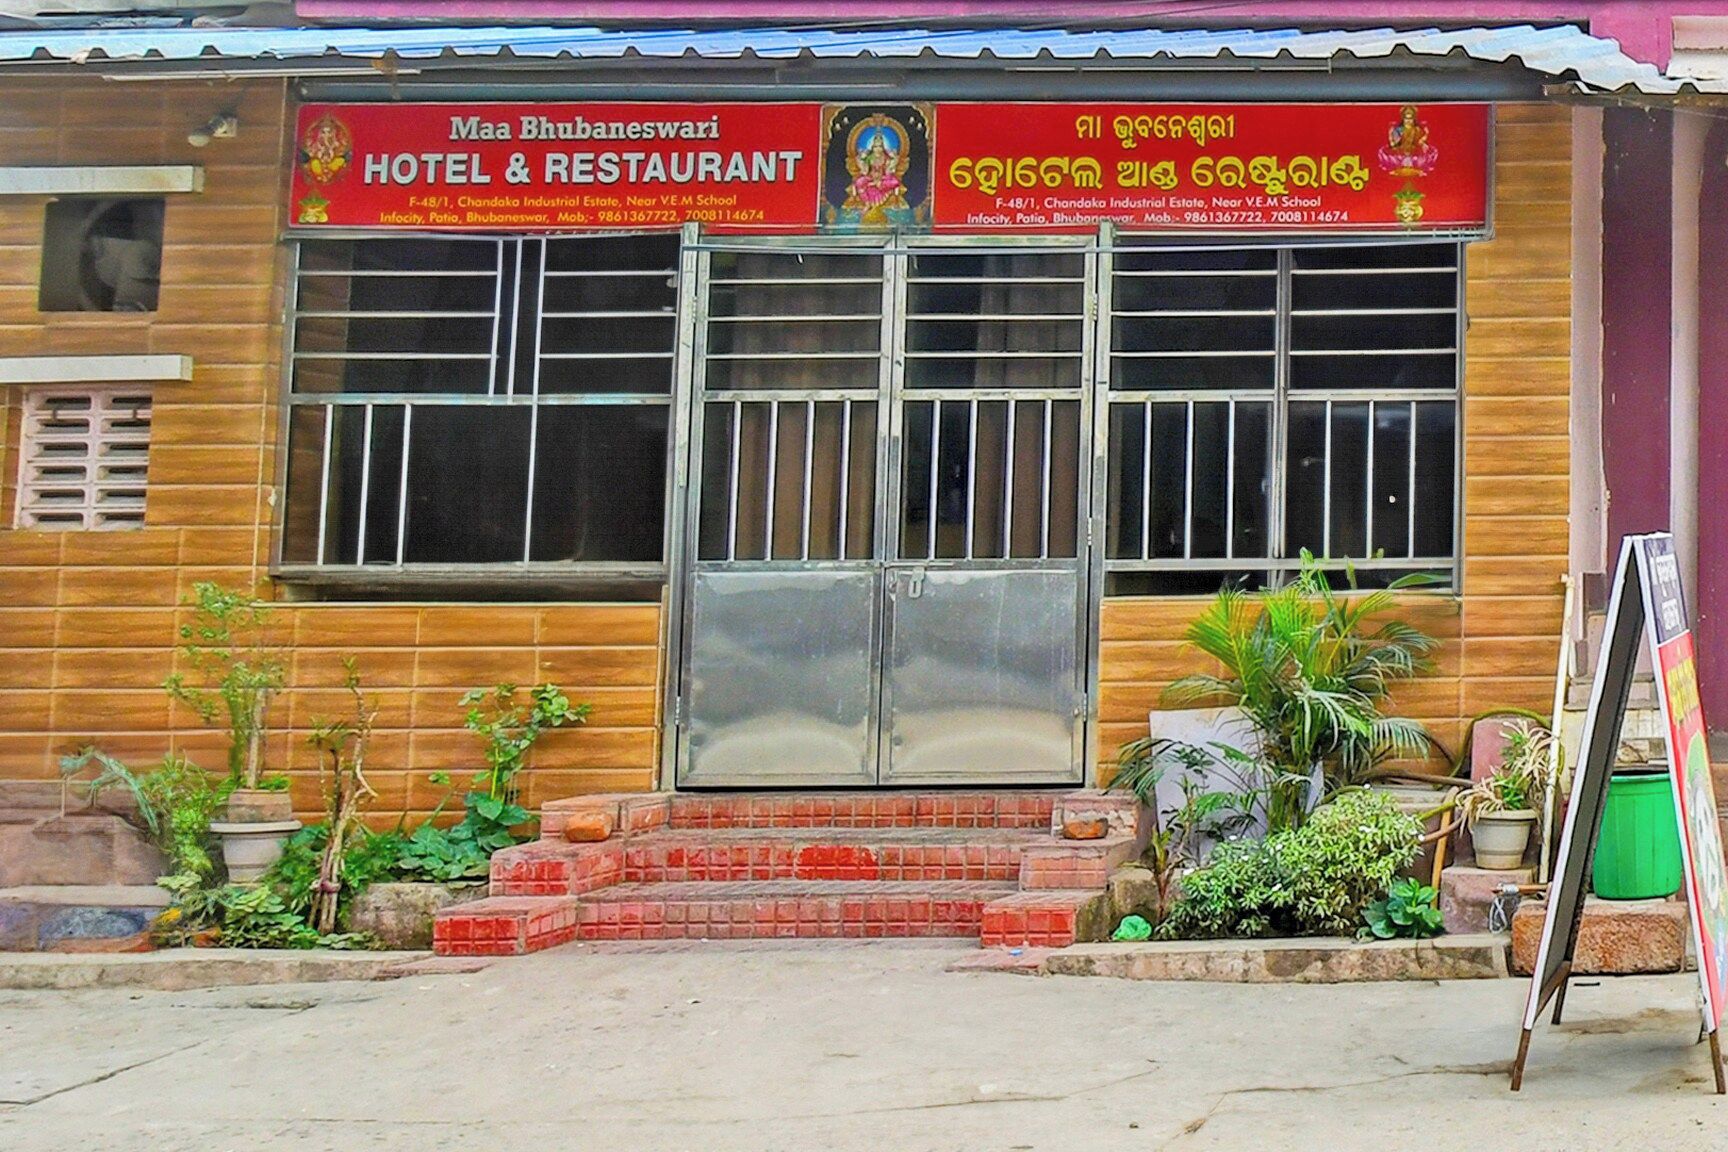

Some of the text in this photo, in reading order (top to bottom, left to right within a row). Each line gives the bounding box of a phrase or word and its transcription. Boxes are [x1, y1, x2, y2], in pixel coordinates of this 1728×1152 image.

[449, 115, 720, 140] Maa Bhubaneswari
[1075, 115, 1101, 139] ମା
[364, 150, 803, 184] HOTEL & RESTAURANT
[949, 156, 1103, 196] ହୋଟେଲ
[1117, 160, 1178, 190] ଆଣ୍ଡ
[409, 197, 454, 209] F-48/1,
[457, 196, 520, 208] Chandaka
[523, 196, 580, 208] Industrial
[583, 196, 622, 208] Estate,
[626, 195, 656, 207] Near
[696, 194, 737, 206] School
[996, 196, 1321, 210] F-48/1, Chandaka Industrial Estate, Near V.E.M School
[380, 212, 425, 225] Infocity,
[429, 212, 462, 225] Patia,
[466, 211, 550, 224] Bhubaneswar,
[598, 211, 680, 223] 9861367722,
[685, 210, 765, 221] 7008114674
[967, 213, 1013, 225] Infocity,
[1016, 213, 1049, 225] Patia,
[1184, 211, 1266, 224] 9861367722,
[1270, 211, 1349, 223] 7008114674
